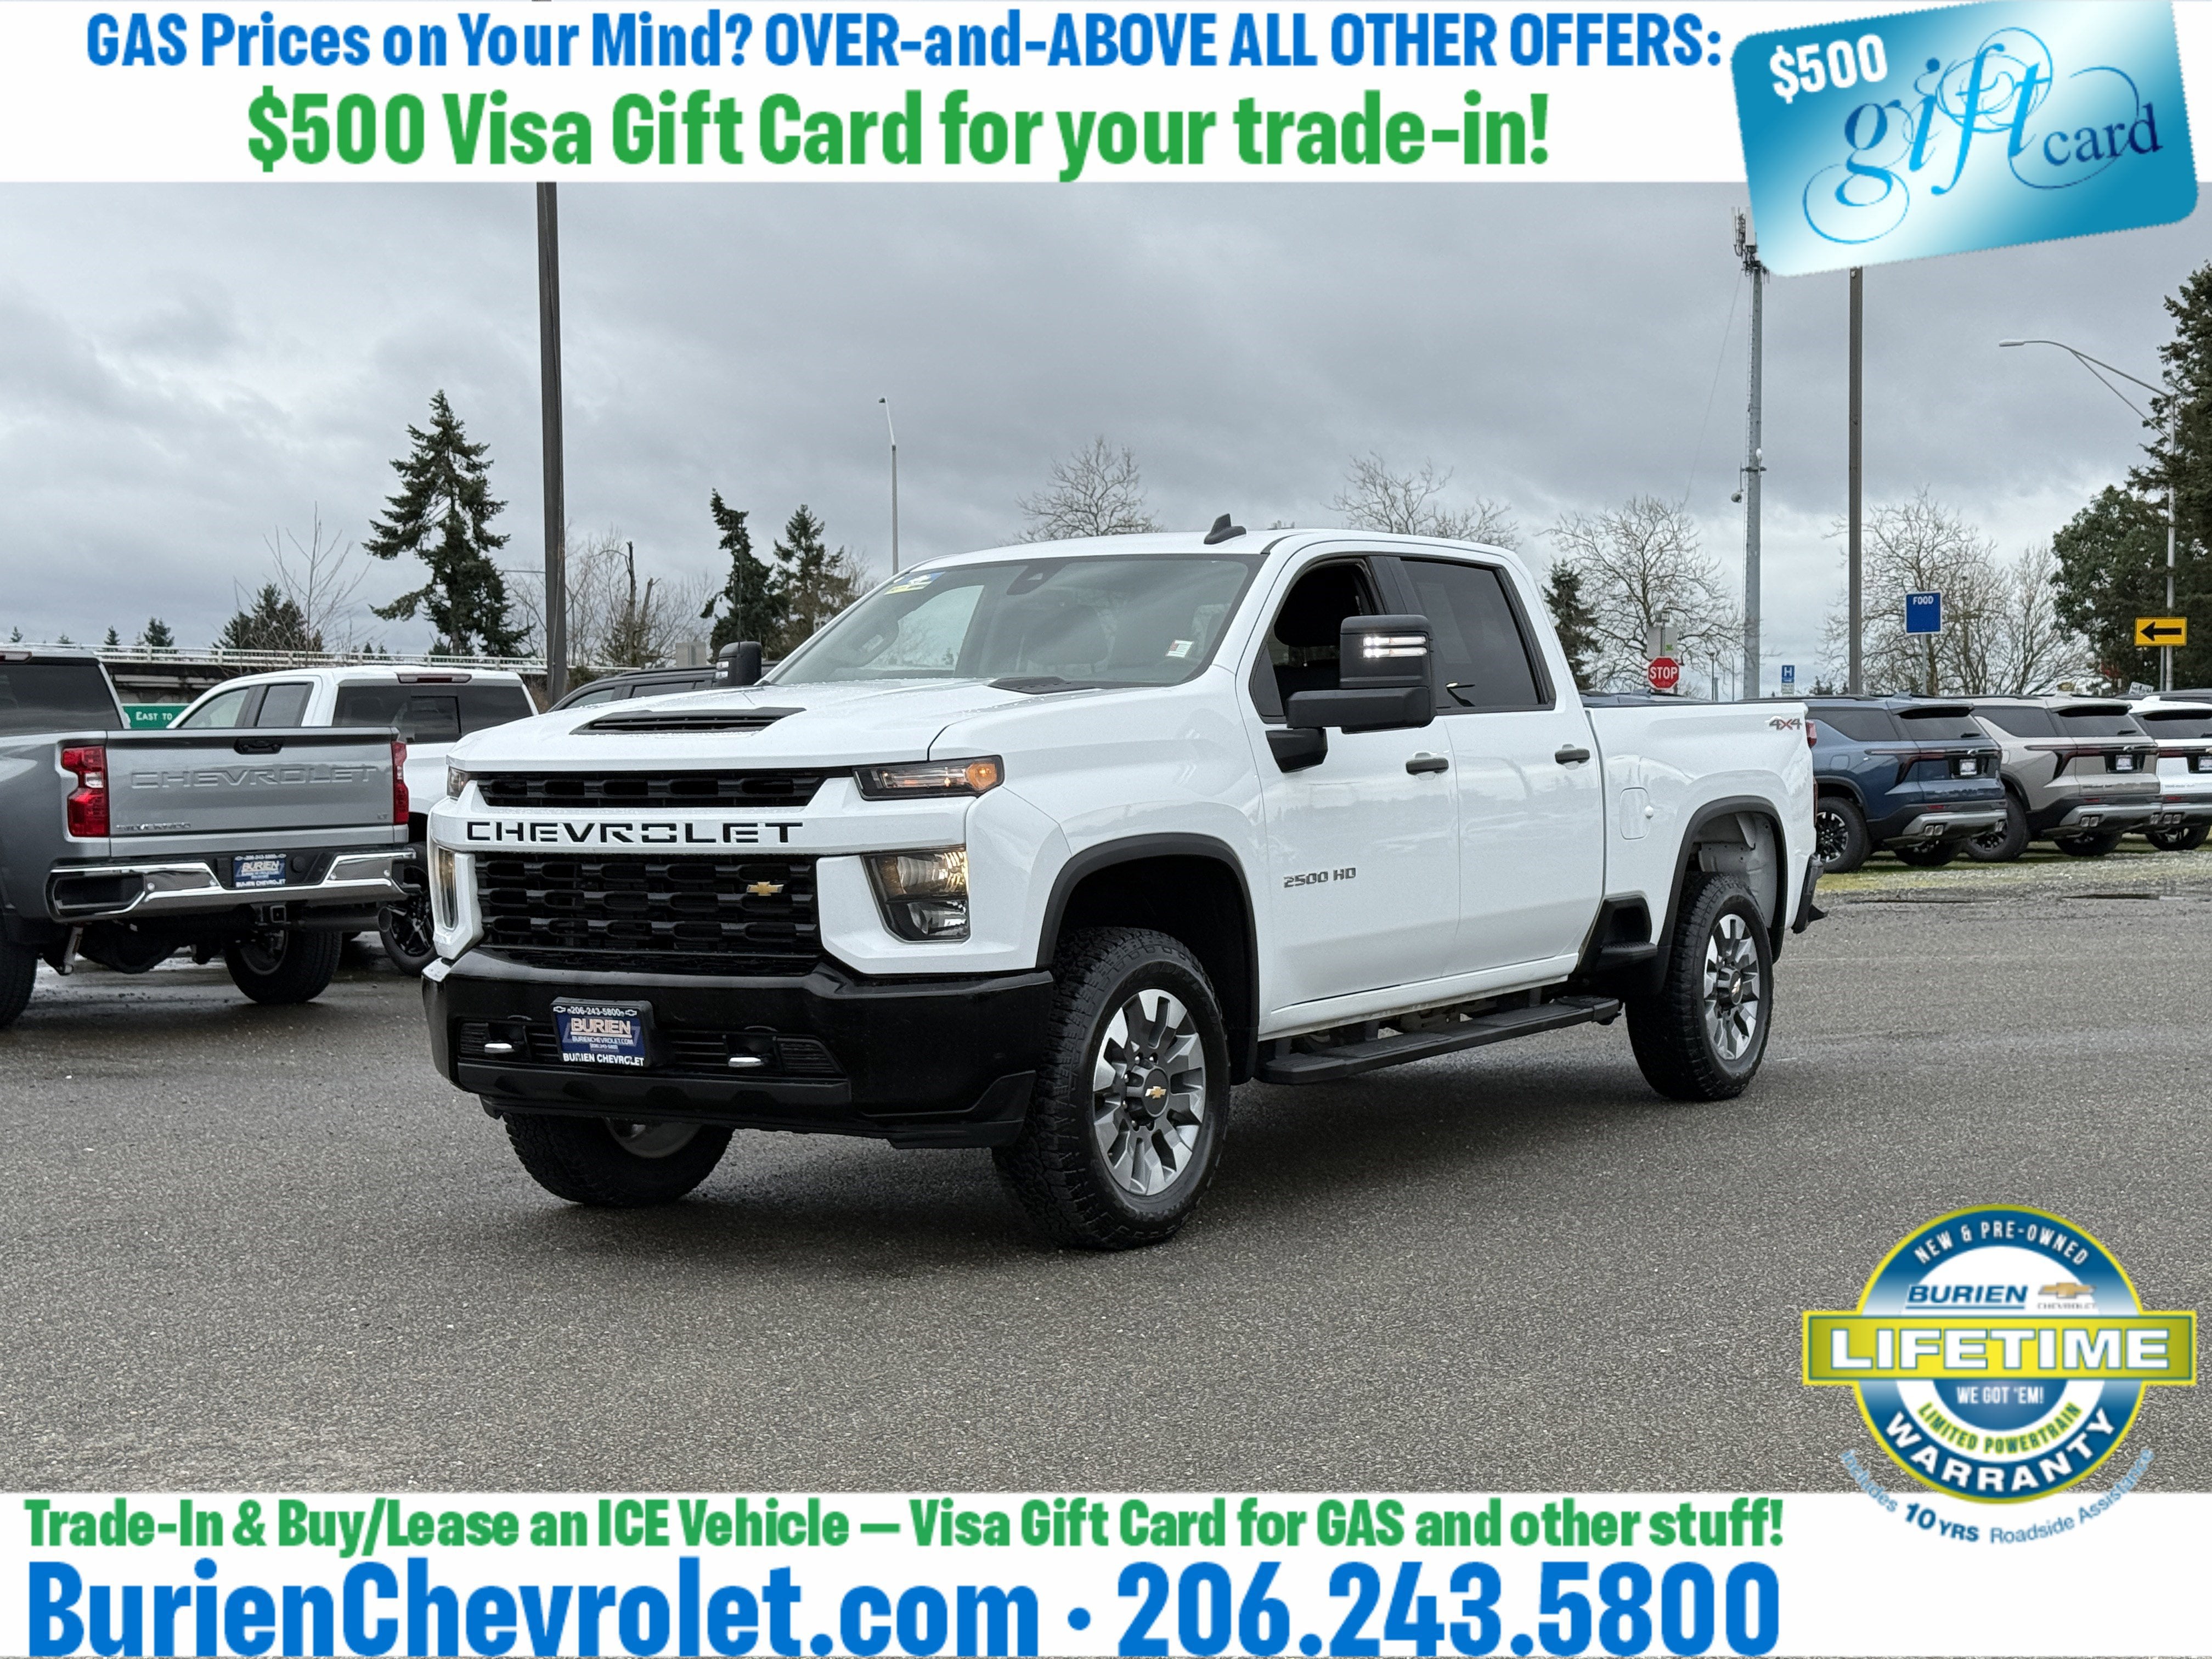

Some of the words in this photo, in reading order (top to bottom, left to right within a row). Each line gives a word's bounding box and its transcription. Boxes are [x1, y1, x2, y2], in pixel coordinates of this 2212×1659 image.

[1913, 595, 1934, 605] FOOD
[1650, 666, 1678, 680] STOP
[1784, 667, 1792, 676] H
[136, 711, 158, 721] EAST
[162, 713, 173, 721] TO
[131, 766, 376, 789] CHEVROLET
[467, 821, 803, 844] CHEVROLET
[1283, 871, 1329, 888] 2500
[1333, 867, 1356, 881] HD
[571, 1018, 631, 1035] BURIEN
[563, 1052, 595, 1062] BURIEN
[597, 1053, 644, 1066] CHEVROLET
